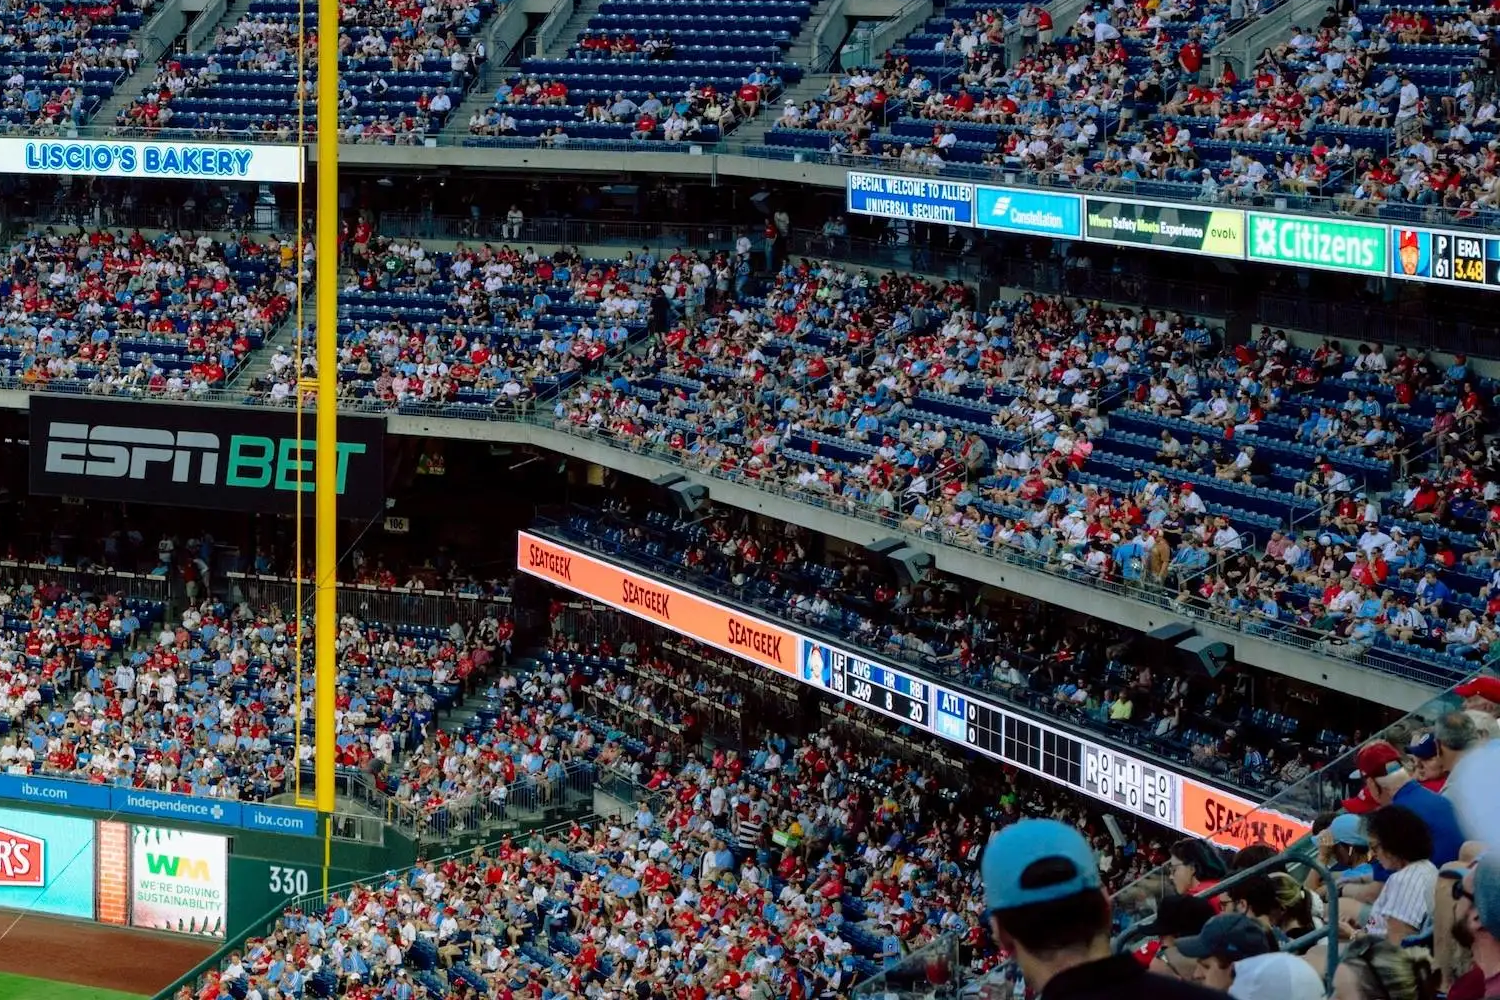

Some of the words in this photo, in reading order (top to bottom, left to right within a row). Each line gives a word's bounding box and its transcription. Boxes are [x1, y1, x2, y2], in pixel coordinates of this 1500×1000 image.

[26, 143, 137, 172] LISCIO'S
[144, 146, 252, 176] BAKERY
[852, 176, 884, 192] SPECIAL
[886, 179, 926, 198] WELCOME
[928, 183, 940, 198] TO
[941, 185, 972, 202] ALLIED
[866, 197, 910, 216] UNIVERSAL
[912, 203, 956, 221] SECURITY!
[1088, 214, 1112, 228] Where
[1112, 216, 1136, 233] Safety
[1137, 218, 1160, 234] Meets
[1160, 222, 1204, 238] Experience
[1211, 228, 1237, 240] evolv
[1279, 222, 1376, 267] Citizens
[1438, 236, 1448, 254] P
[1458, 239, 1482, 258] ERA
[1436, 258, 1449, 278] 61
[1455, 258, 1484, 280] 3.48
[45, 422, 220, 485] ESPN
[226, 434, 366, 495] BET
[530, 544, 572, 582] SEATGEEK
[622, 578, 670, 620] SEATGEEK
[728, 618, 782, 664] SEATGEEK
[834, 652, 844, 670] LF
[852, 662, 871, 682] AVG
[883, 671, 896, 688] HR
[909, 680, 924, 698] RBI
[833, 674, 844, 692] 18
[852, 680, 872, 702] .249
[885, 691, 893, 711] 8
[909, 704, 922, 722] 20
[942, 694, 962, 716] ATL
[942, 714, 960, 736] PHI
[22, 782, 68, 800] ibx.com
[1087, 758, 1098, 784] R
[1115, 768, 1126, 795] H
[1144, 777, 1155, 806] E
[127, 795, 208, 818] Independence
[254, 811, 304, 829] ibx.com
[146, 852, 212, 882] WM
[140, 879, 174, 894] WE'RE
[176, 884, 220, 900] DRIVING
[269, 866, 308, 896] 330
[137, 890, 222, 912] SUSTAINABILITY
